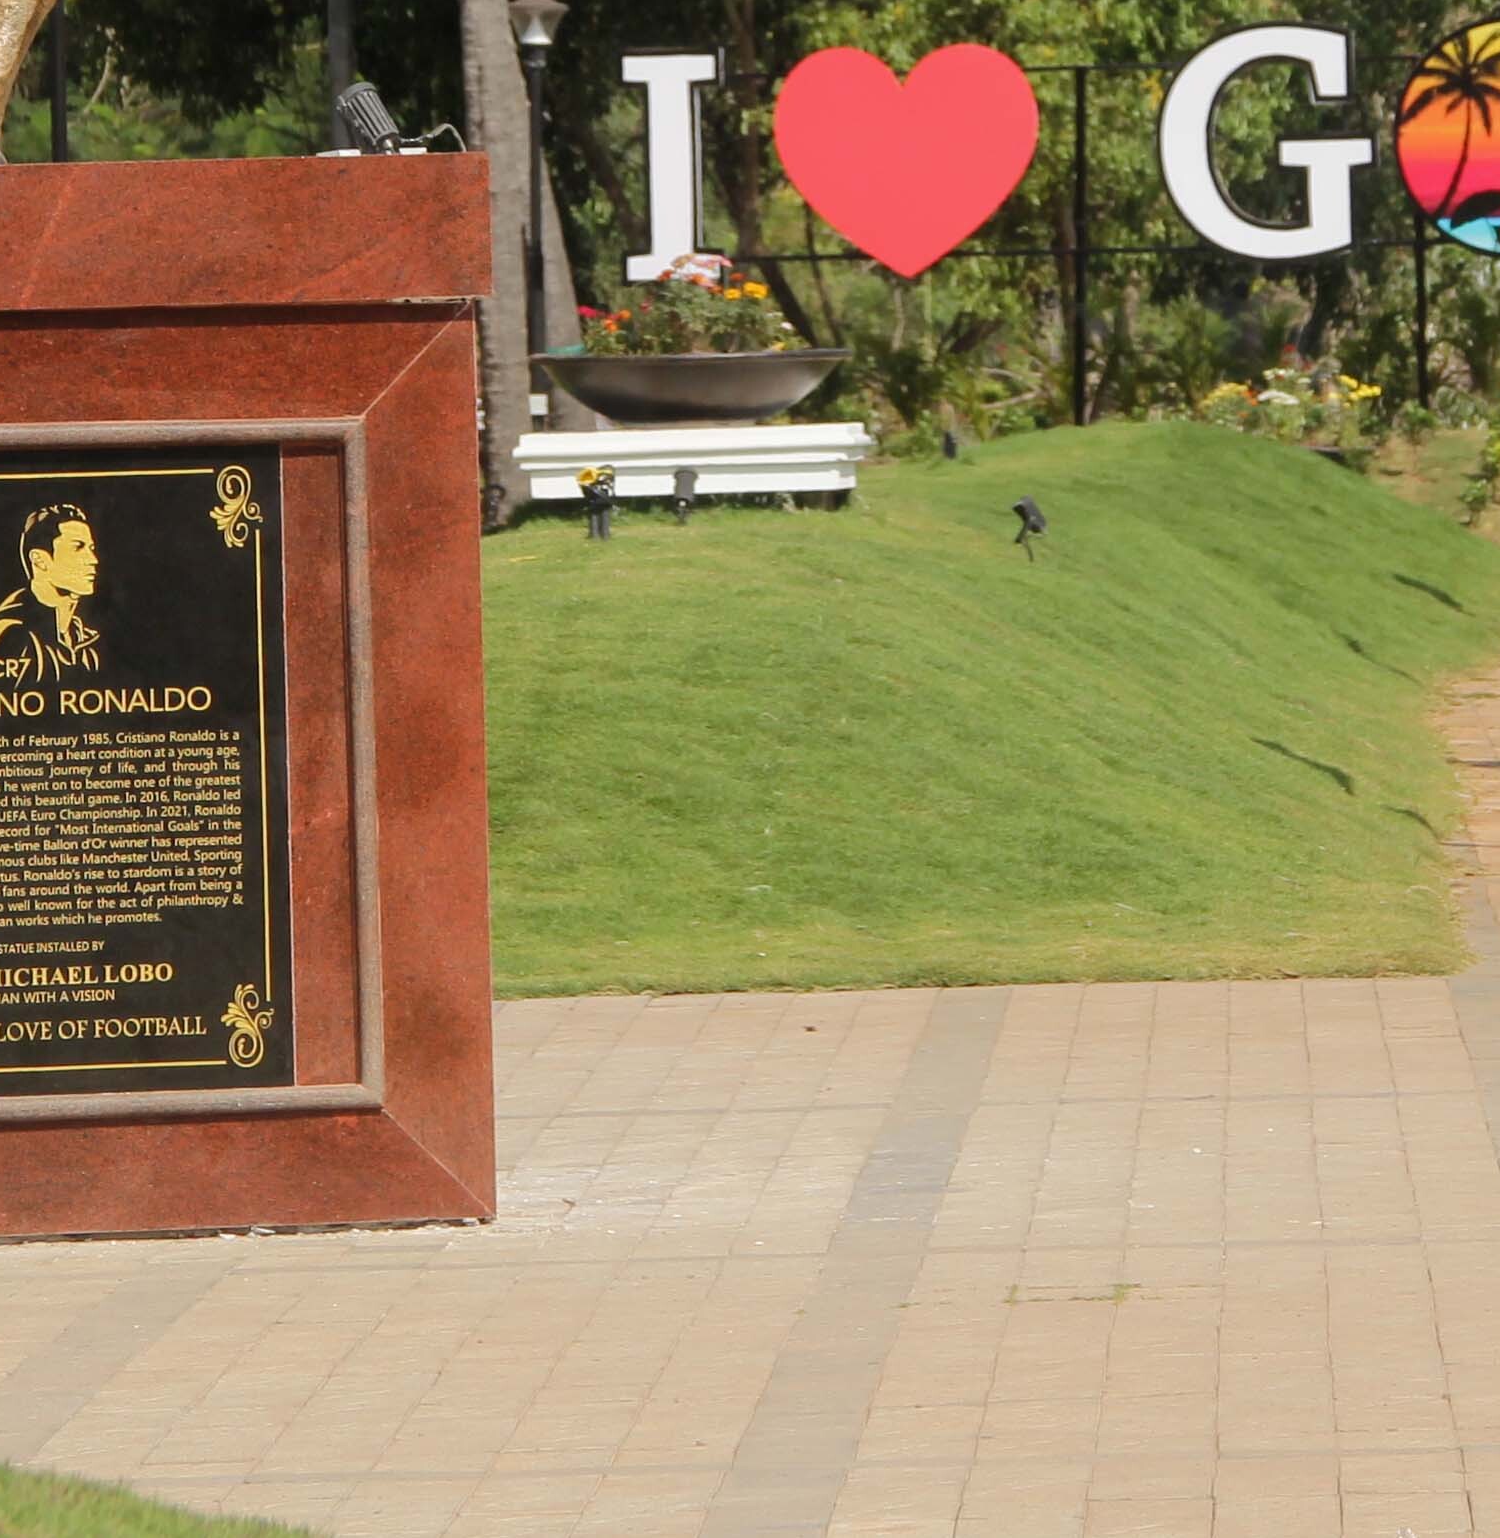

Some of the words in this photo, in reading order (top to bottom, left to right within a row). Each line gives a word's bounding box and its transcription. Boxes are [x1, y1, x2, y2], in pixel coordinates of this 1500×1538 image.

[621, 53, 722, 282] I
[60, 688, 211, 715] RONALDO
[13, 736, 25, 747] of
[29, 734, 78, 750] February
[116, 731, 166, 744] Cristiano
[170, 730, 216, 742] Ronaldo
[220, 729, 229, 741] is
[232, 732, 240, 740] a
[56, 752, 64, 761] a
[66, 749, 96, 760] heart
[98, 747, 152, 760] condition
[154, 746, 166, 758] at
[168, 749, 175, 757] a
[177, 748, 214, 760] young
[49, 764, 94, 779] journey
[99, 763, 112, 774] of
[144, 761, 166, 773] and
[172, 760, 218, 775] through
[224, 759, 240, 770] his
[4, 781, 18, 792] he
[20, 780, 49, 792] went
[52, 782, 67, 791] on
[70, 779, 82, 790] to
[85, 778, 131, 790] become
[134, 779, 156, 788] one
[158, 776, 170, 788] of
[173, 776, 192, 787] the
[194, 774, 241, 790] greatest
[11, 796, 32, 807] this
[35, 794, 84, 806] beautiful
[88, 795, 123, 808] game.
[126, 792, 136, 804] In
[173, 790, 220, 802] Ronaldo
[223, 789, 241, 800] led
[30, 810, 56, 822] Euro
[59, 807, 143, 824] Championship.
[146, 807, 158, 818] In
[194, 804, 241, 816] Ronaldo
[34, 825, 51, 836] for
[92, 822, 164, 835] International
[208, 820, 219, 831] in
[223, 819, 242, 830] the
[43, 839, 78, 851] Ballon
[109, 837, 149, 849] winner
[151, 836, 172, 848] has
[174, 834, 242, 850] represented
[28, 855, 58, 867] clubs
[60, 854, 80, 866] like
[82, 852, 149, 865] Manchester
[194, 849, 242, 865] Sporting
[84, 868, 105, 880] rise
[107, 868, 120, 879] to
[123, 866, 172, 879] stardom
[175, 866, 184, 877] is
[187, 868, 195, 877] a
[197, 864, 227, 880] story
[229, 864, 242, 875] of
[2, 886, 26, 898] fans
[29, 884, 70, 897] around
[73, 884, 92, 895] the
[95, 883, 130, 895] world.
[134, 881, 166, 896] Apart
[169, 880, 196, 892] from
[200, 879, 232, 894] being
[236, 882, 243, 890] a
[8, 901, 30, 912] well
[34, 899, 72, 912] known
[76, 899, 93, 910] for
[97, 898, 116, 910] the
[119, 897, 137, 909] act
[140, 897, 153, 908] of
[157, 894, 229, 911] philanthropy
[232, 894, 244, 905] &
[15, 915, 49, 927] works
[52, 914, 85, 926] which
[88, 913, 103, 925] he
[105, 912, 162, 928] promotes.
[36, 941, 90, 953] INSTALLED
[92, 941, 105, 952] BY
[104, 964, 173, 984] LOBO
[23, 991, 56, 1004] WITH
[59, 991, 69, 1003] A
[72, 990, 115, 1002] VISION
[58, 1020, 88, 1040] OF
[94, 1017, 207, 1039] FOOTBALL
